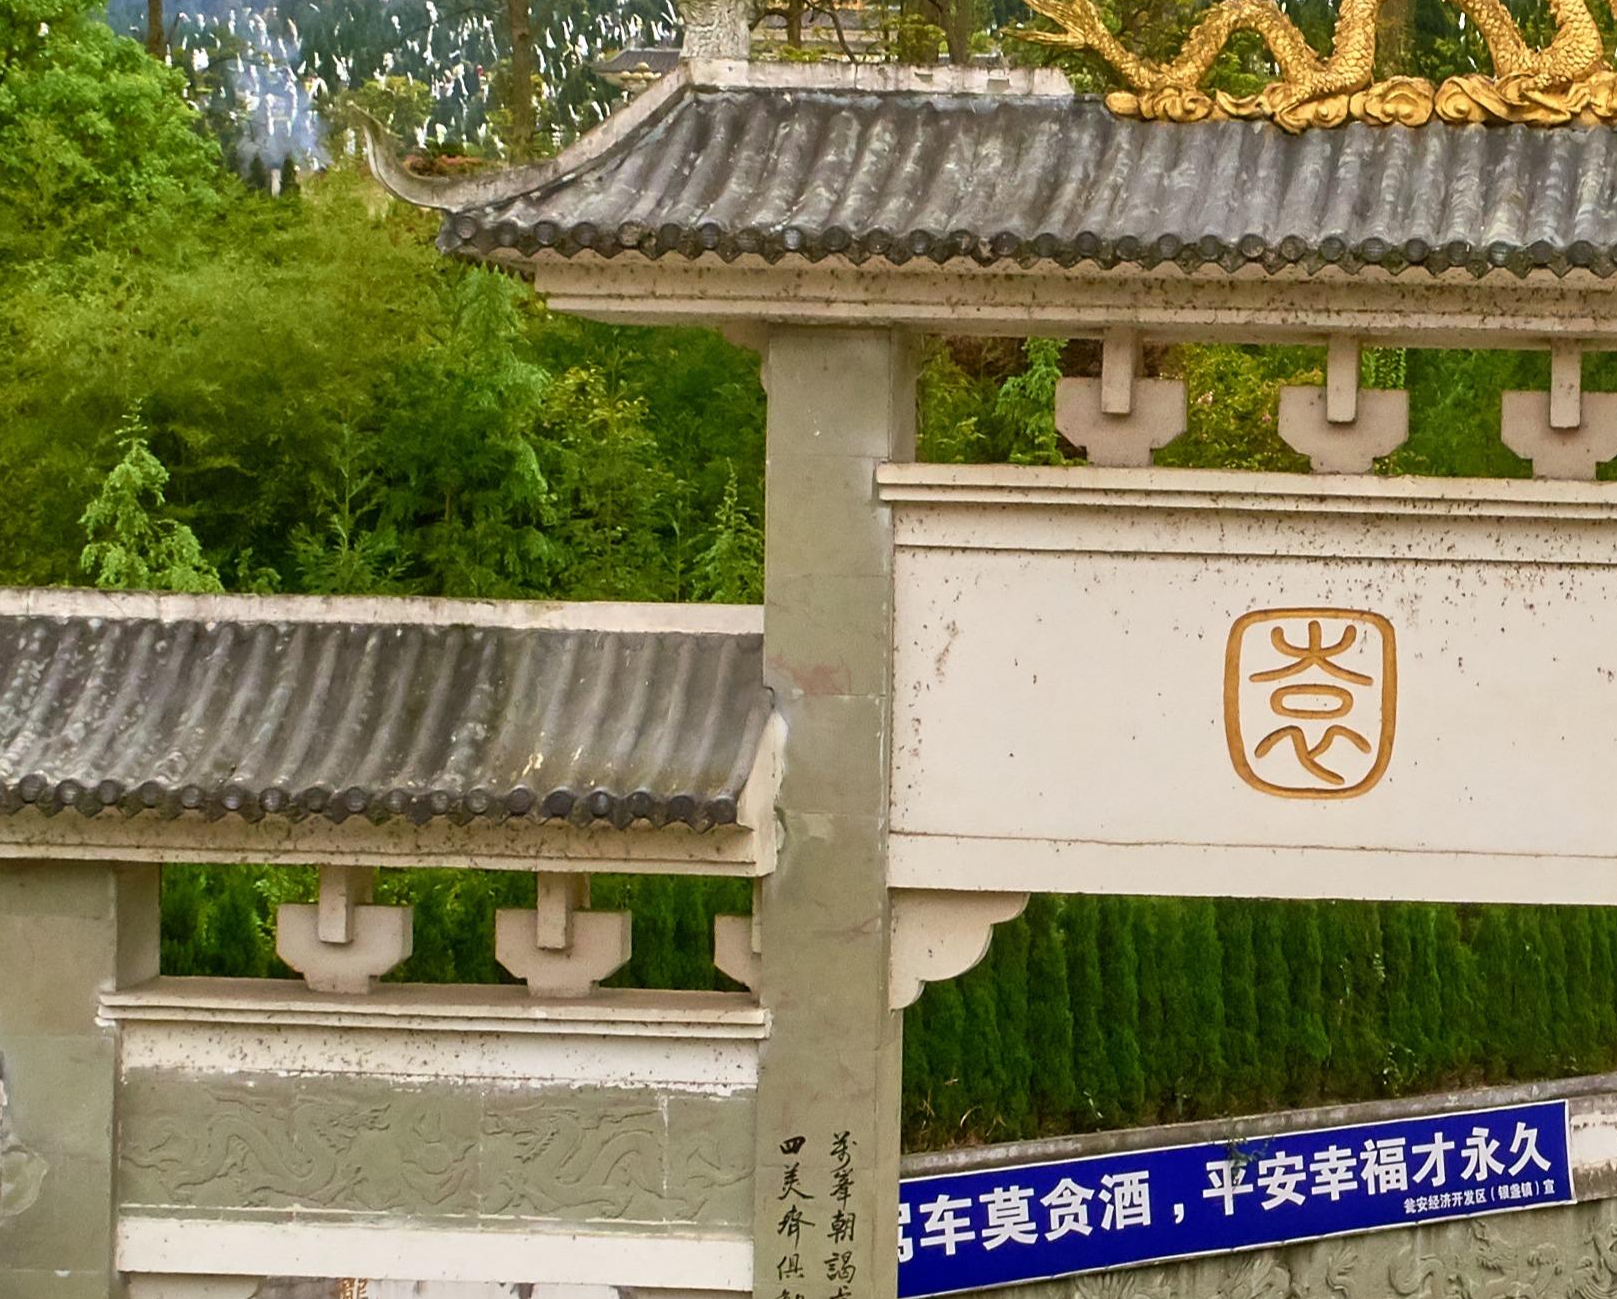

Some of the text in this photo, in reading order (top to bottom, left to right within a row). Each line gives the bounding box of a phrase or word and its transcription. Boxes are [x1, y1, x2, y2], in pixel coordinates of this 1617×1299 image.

[897, 1121, 1552, 1263] 车莫贪酒，平安幸福才永久
